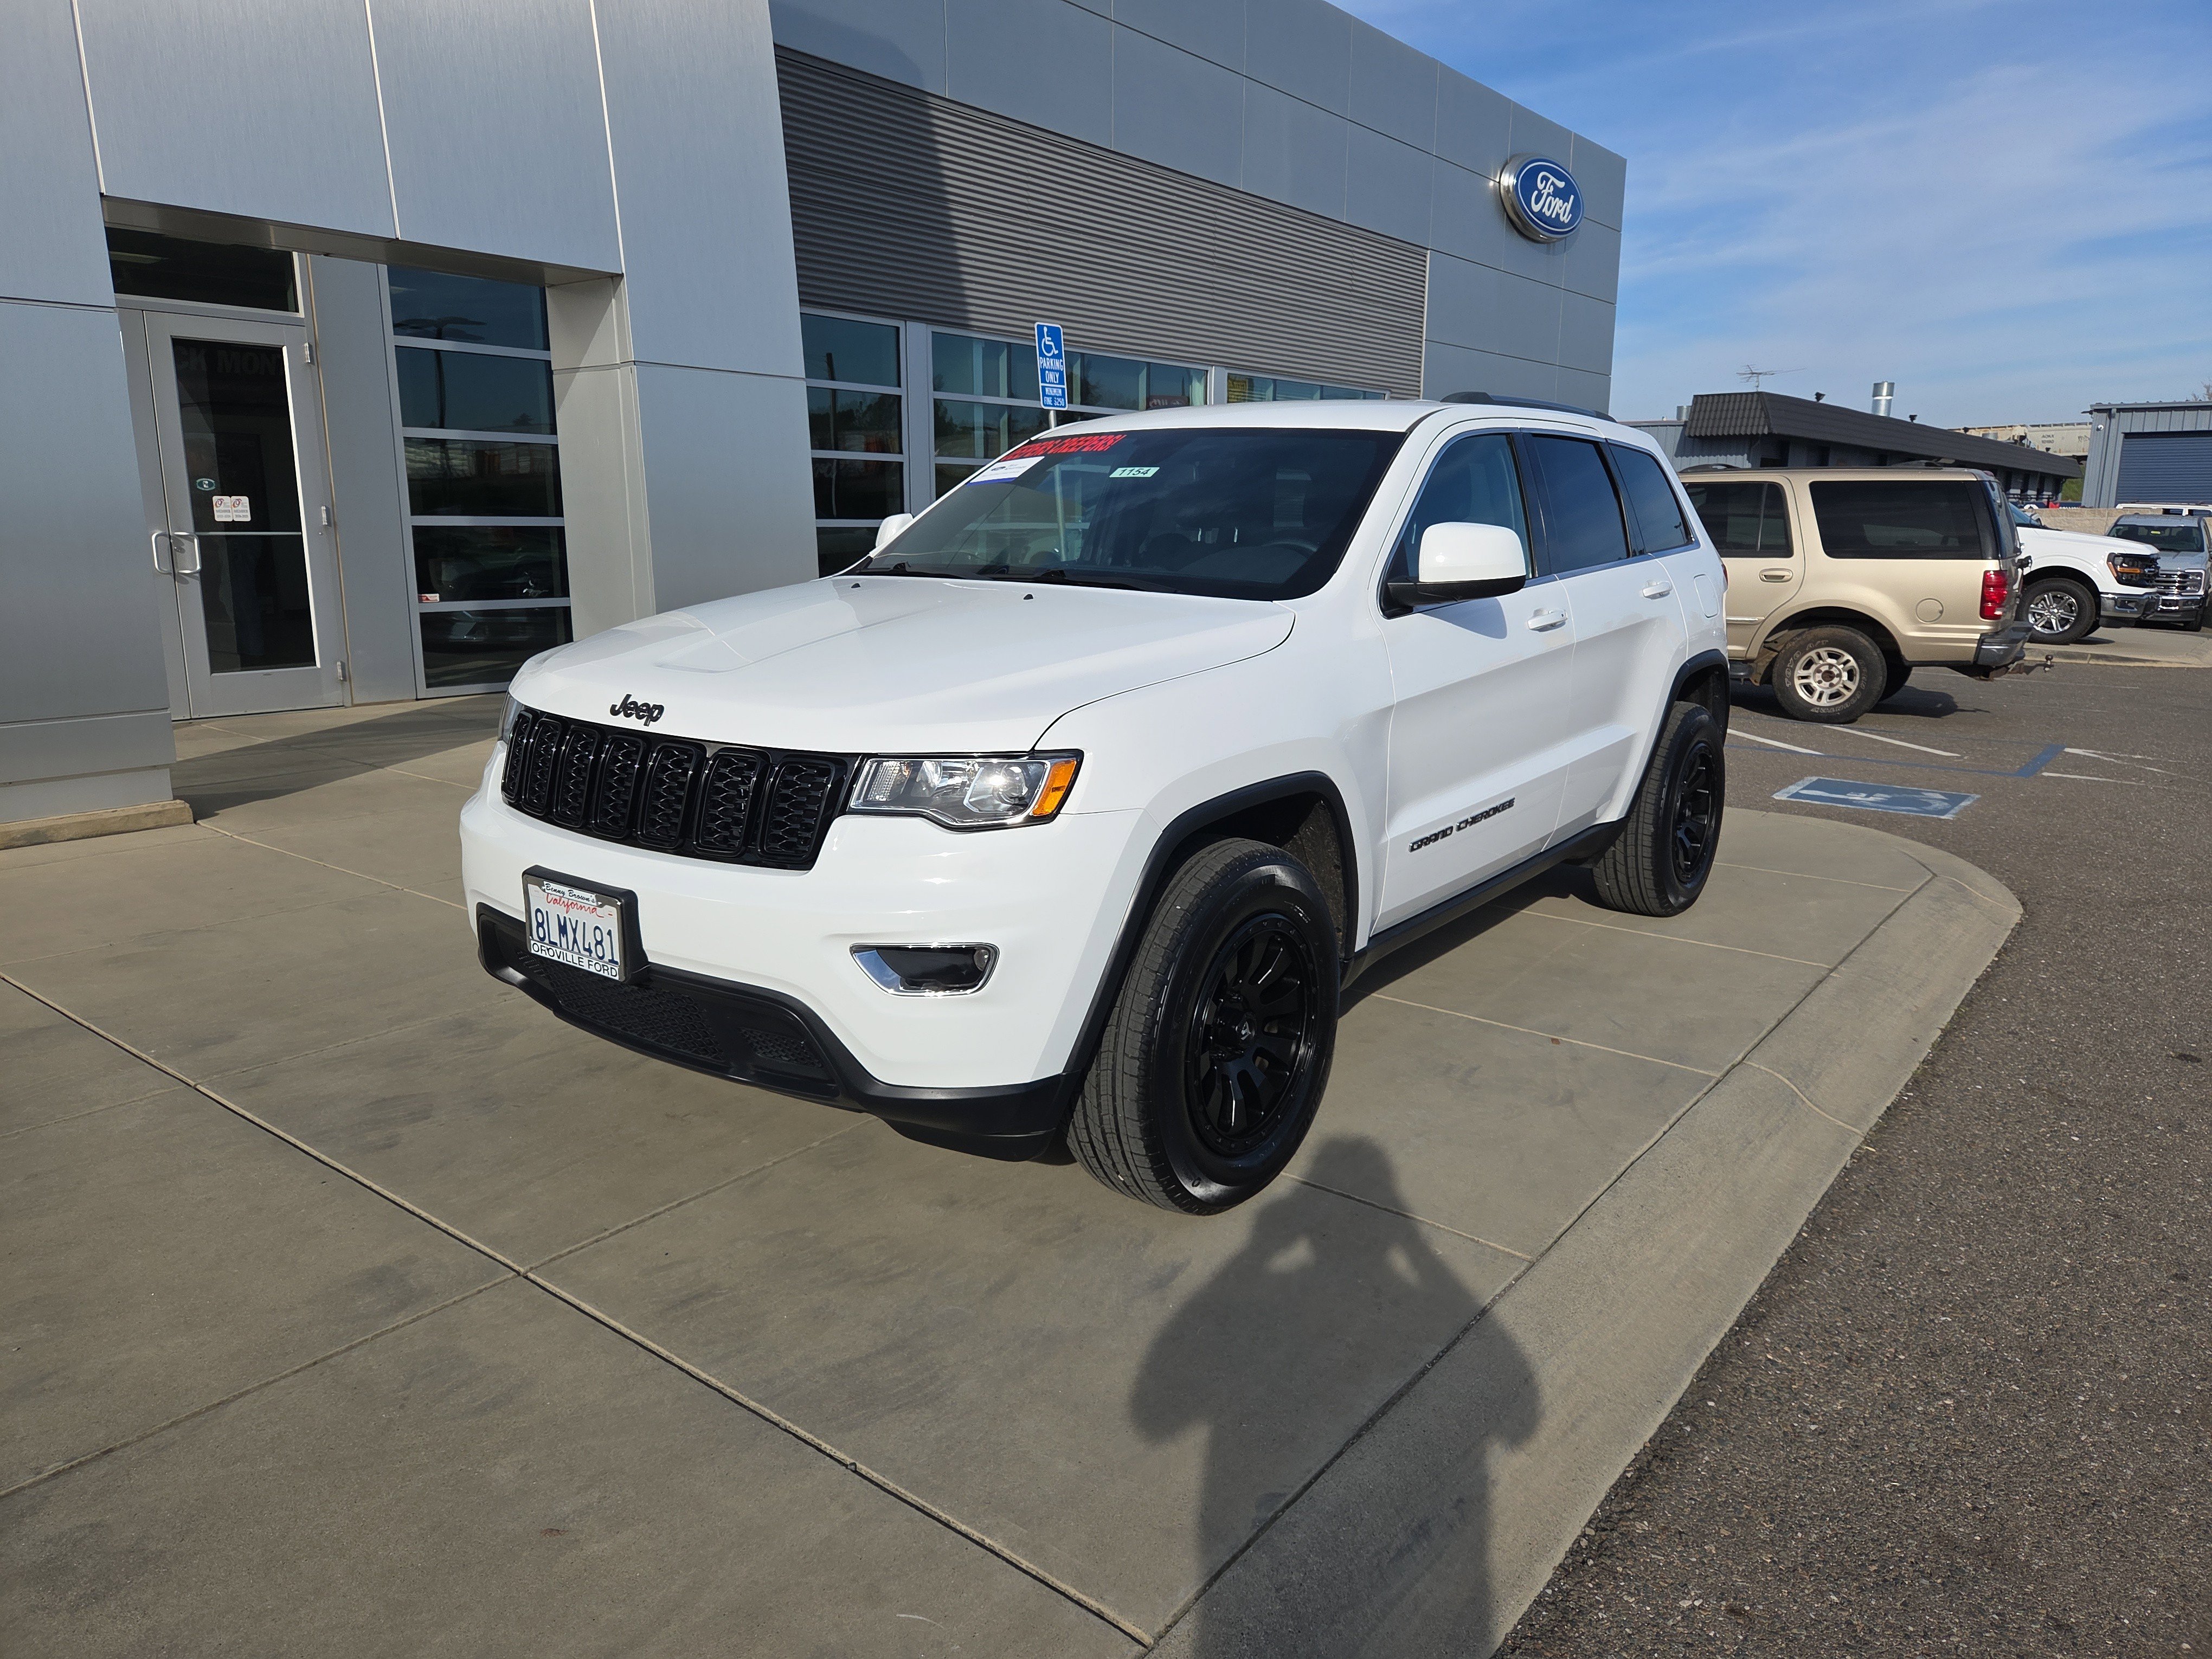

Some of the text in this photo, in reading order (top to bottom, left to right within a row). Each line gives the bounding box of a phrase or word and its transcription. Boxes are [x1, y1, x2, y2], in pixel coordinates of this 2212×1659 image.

[1531, 171, 1574, 223] Ford
[1039, 357, 1064, 371] PARKING
[1045, 371, 1059, 383] ONLY
[1047, 434, 1127, 454] CREEPERS!
[609, 693, 665, 727] Jeep
[1408, 796, 1515, 853] GRAND CHEROKEE
[545, 883, 596, 903] Benny Brown's
[546, 893, 605, 918] California
[535, 908, 619, 966] 8LMX481
[532, 942, 618, 978] OROVILLE FORD
